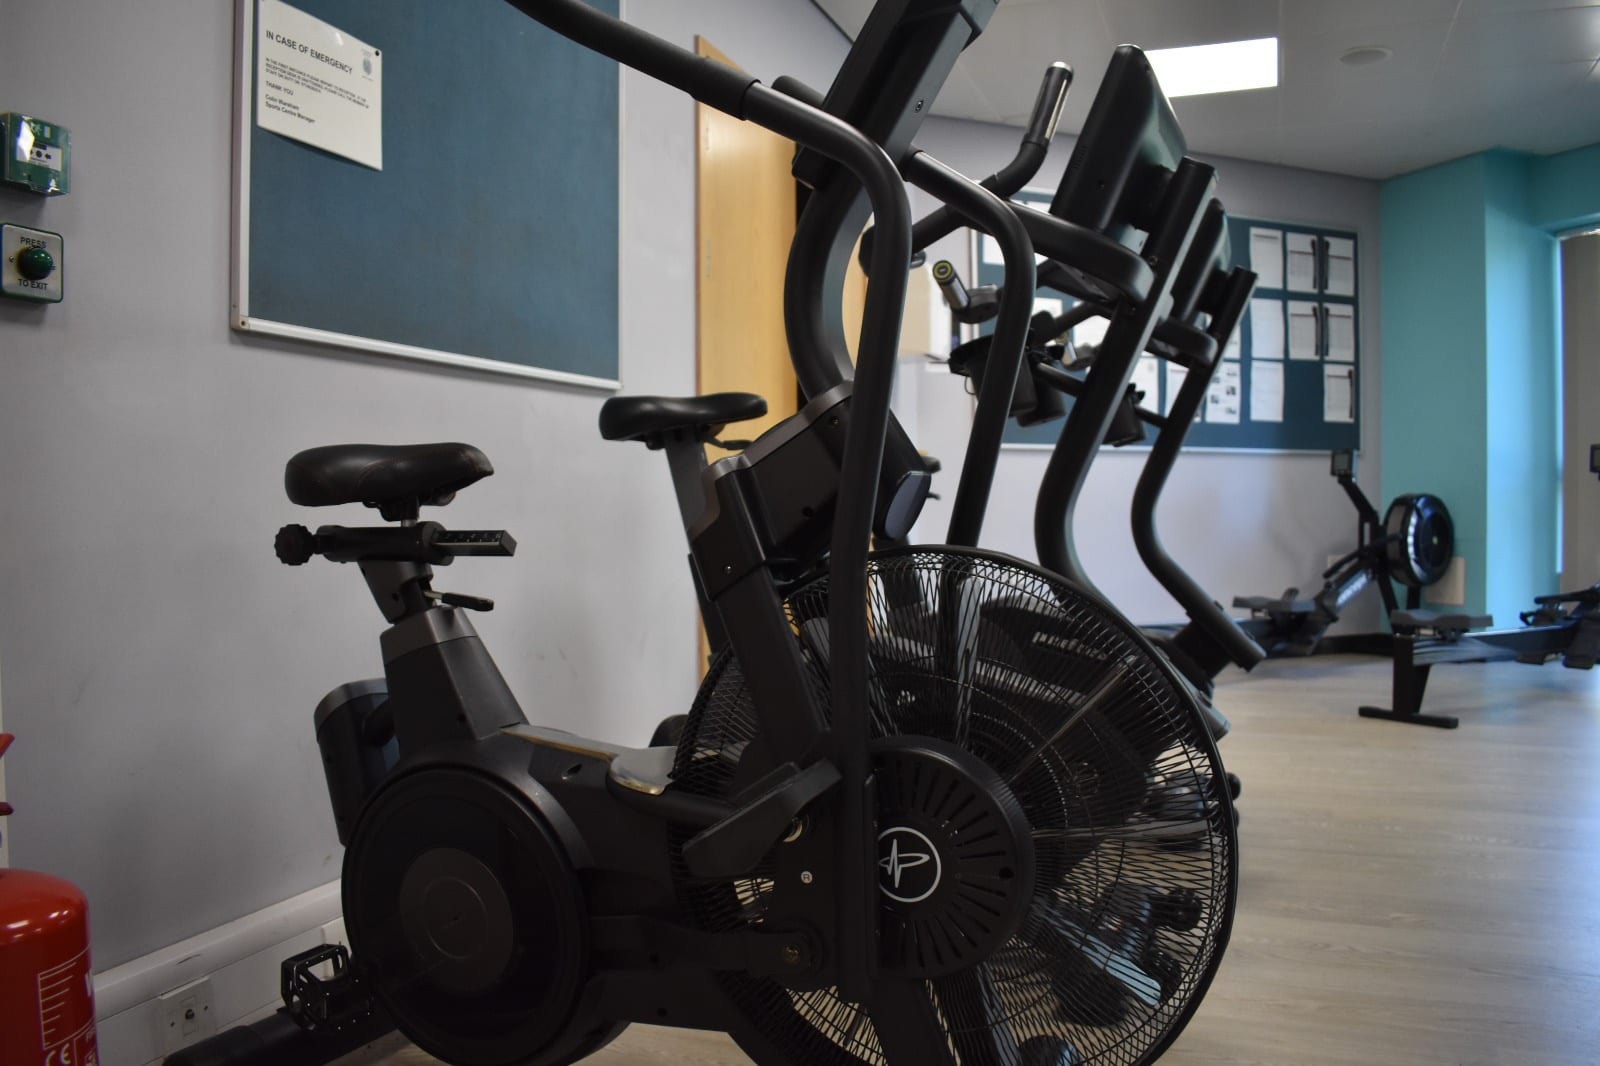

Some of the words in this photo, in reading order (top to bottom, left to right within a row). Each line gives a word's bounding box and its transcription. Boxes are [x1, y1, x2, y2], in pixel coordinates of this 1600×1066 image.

[266, 30, 274, 41] IN
[276, 34, 297, 50] CASE
[298, 44, 309, 55] OF
[310, 49, 353, 75] EMERGENCY
[283, 87, 294, 96] YOU
[20, 236, 47, 249] PRESS
[17, 278, 29, 288] TO
[31, 280, 48, 291] EXIT
